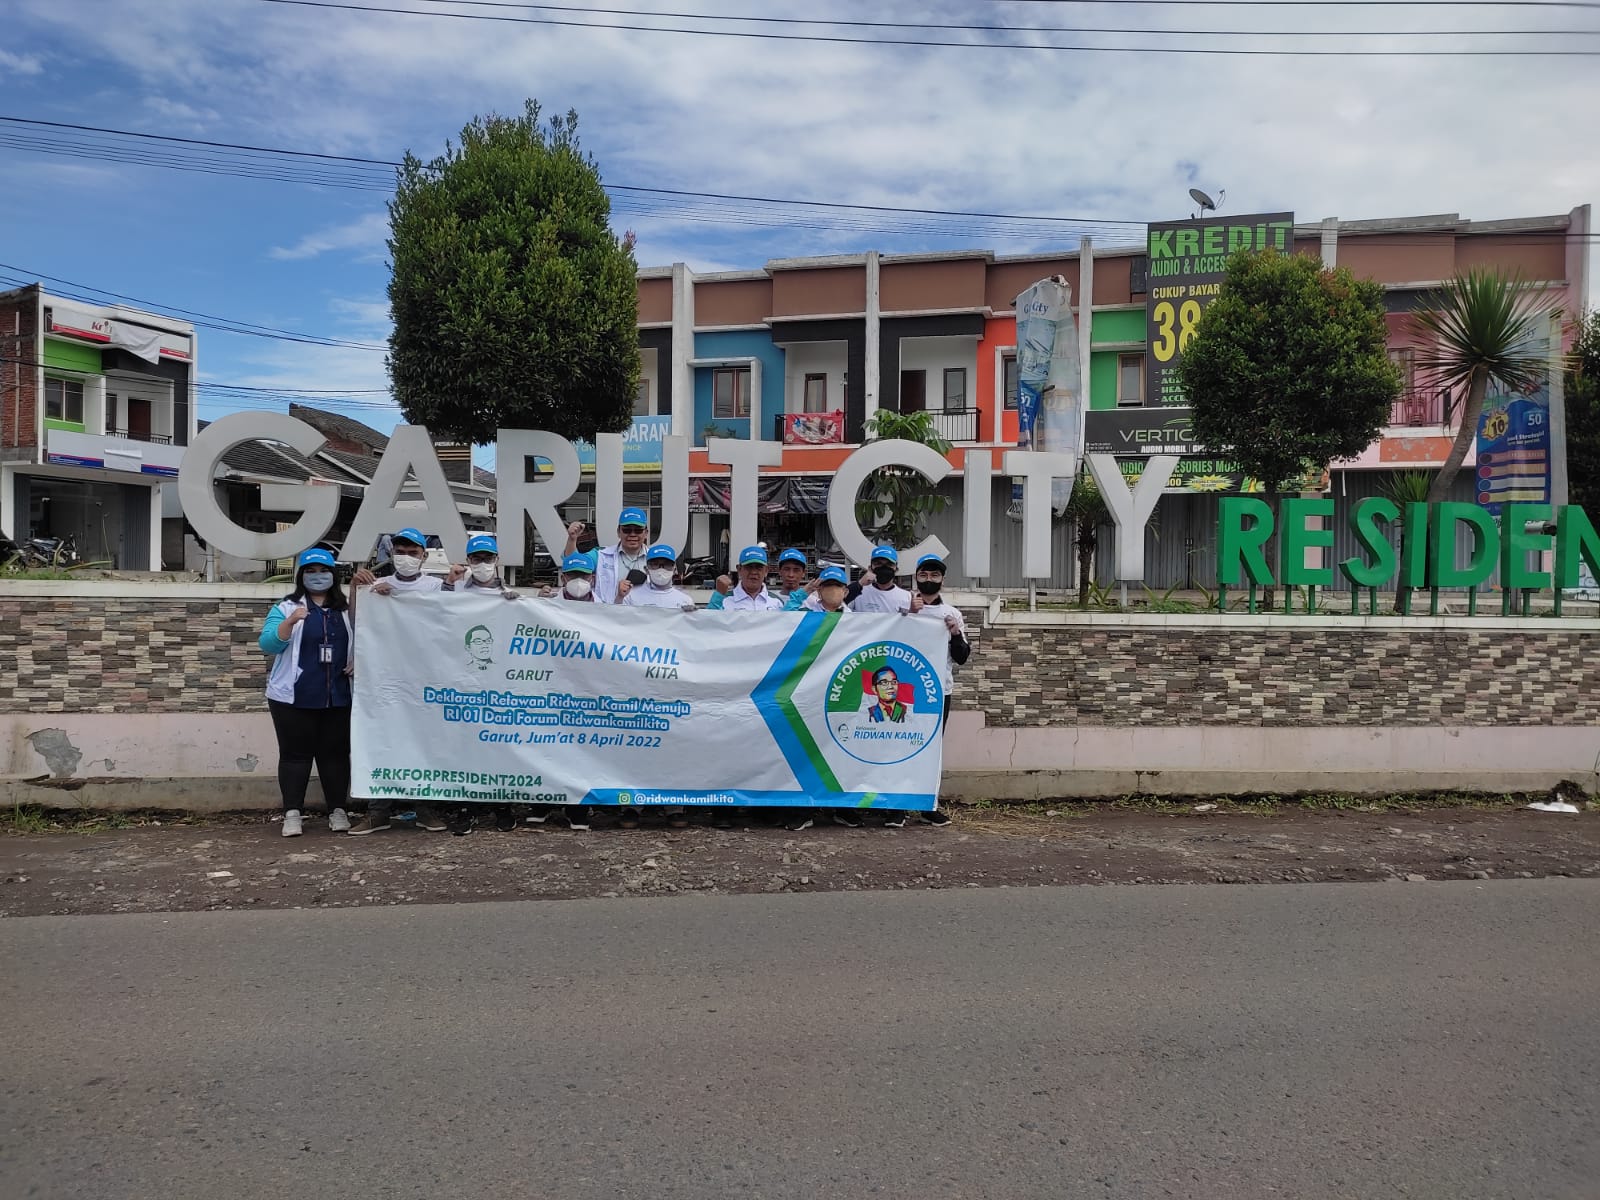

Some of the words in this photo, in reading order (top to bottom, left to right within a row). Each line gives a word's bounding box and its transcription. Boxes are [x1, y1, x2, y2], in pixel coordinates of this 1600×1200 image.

[1151, 221, 1293, 258] KREDIT
[1151, 259, 1180, 277] AUDIO
[1183, 258, 1192, 274] &
[1193, 255, 1229, 273] ACCES
[1153, 286, 1186, 299] CUKUP
[1189, 283, 1221, 296] BAYAR
[1528, 413, 1542, 426] 50
[1120, 429, 1197, 442] VERTIC
[1141, 445, 1163, 454] AUDIO
[1164, 445, 1187, 454] MOBIL
[178, 411, 783, 572] GARUT
[828, 439, 1181, 581] CITY
[515, 624, 581, 639] Relawan
[509, 638, 605, 659] RIDWAN
[610, 644, 680, 665] KAMIL
[505, 669, 553, 681] GARUT
[645, 666, 678, 679] KITA
[830, 683, 843, 702] RK
[837, 657, 861, 683] FOR
[860, 645, 926, 672] PRESIDENT
[919, 672, 938, 704] 2024
[424, 688, 487, 705] Deklarasi
[489, 691, 546, 707] Relawan
[548, 694, 598, 709] Ridwan
[599, 697, 640, 712] Kamil
[640, 699, 690, 716] Menuju
[445, 706, 460, 720] RI
[463, 708, 479, 722] 01
[482, 708, 513, 724] Dari
[514, 710, 559, 725] Forum
[560, 711, 669, 730] Ridwankamilkita
[479, 730, 522, 744] Garut,
[577, 733, 586, 744] 8
[589, 733, 624, 747] April
[626, 735, 661, 747] 2022
[853, 731, 893, 740] RIDWAN
[894, 731, 925, 741] KAMIL
[371, 768, 542, 787] #RKFORPRESIDENT2024
[369, 784, 567, 802] www.ridwankamilkita.com
[634, 793, 734, 805] @ridwankamilkita
